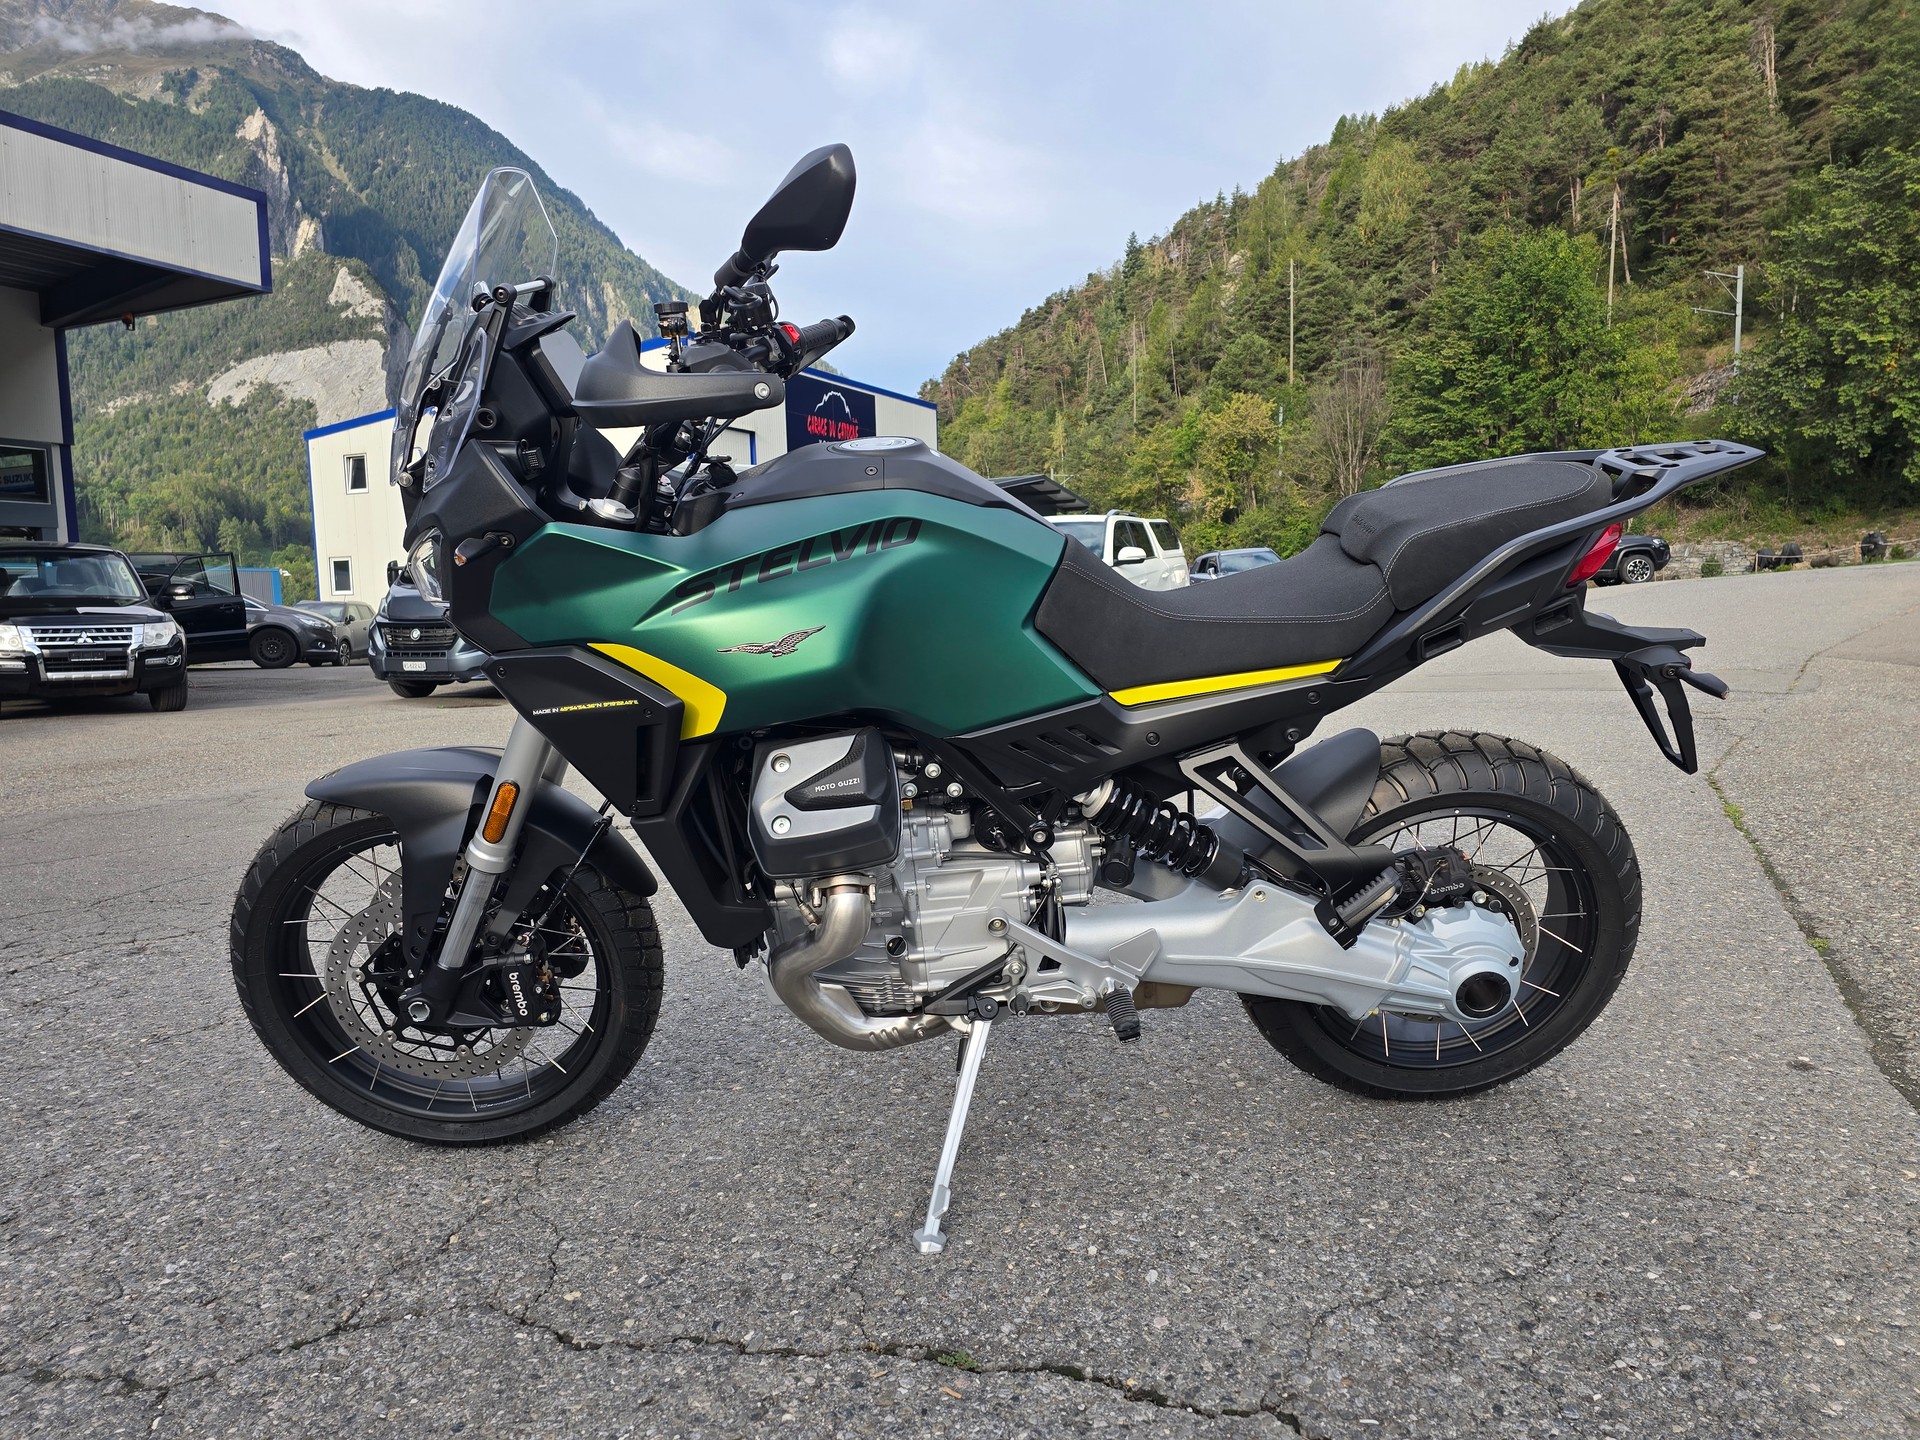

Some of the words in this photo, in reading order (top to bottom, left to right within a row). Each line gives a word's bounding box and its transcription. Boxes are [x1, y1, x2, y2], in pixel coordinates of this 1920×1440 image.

[671, 516, 923, 616] STELVIO
[815, 782, 836, 793] MOTO
[838, 777, 860, 787] GUZZI
[1430, 882, 1465, 895] brembo
[509, 972, 528, 1016] brembo
